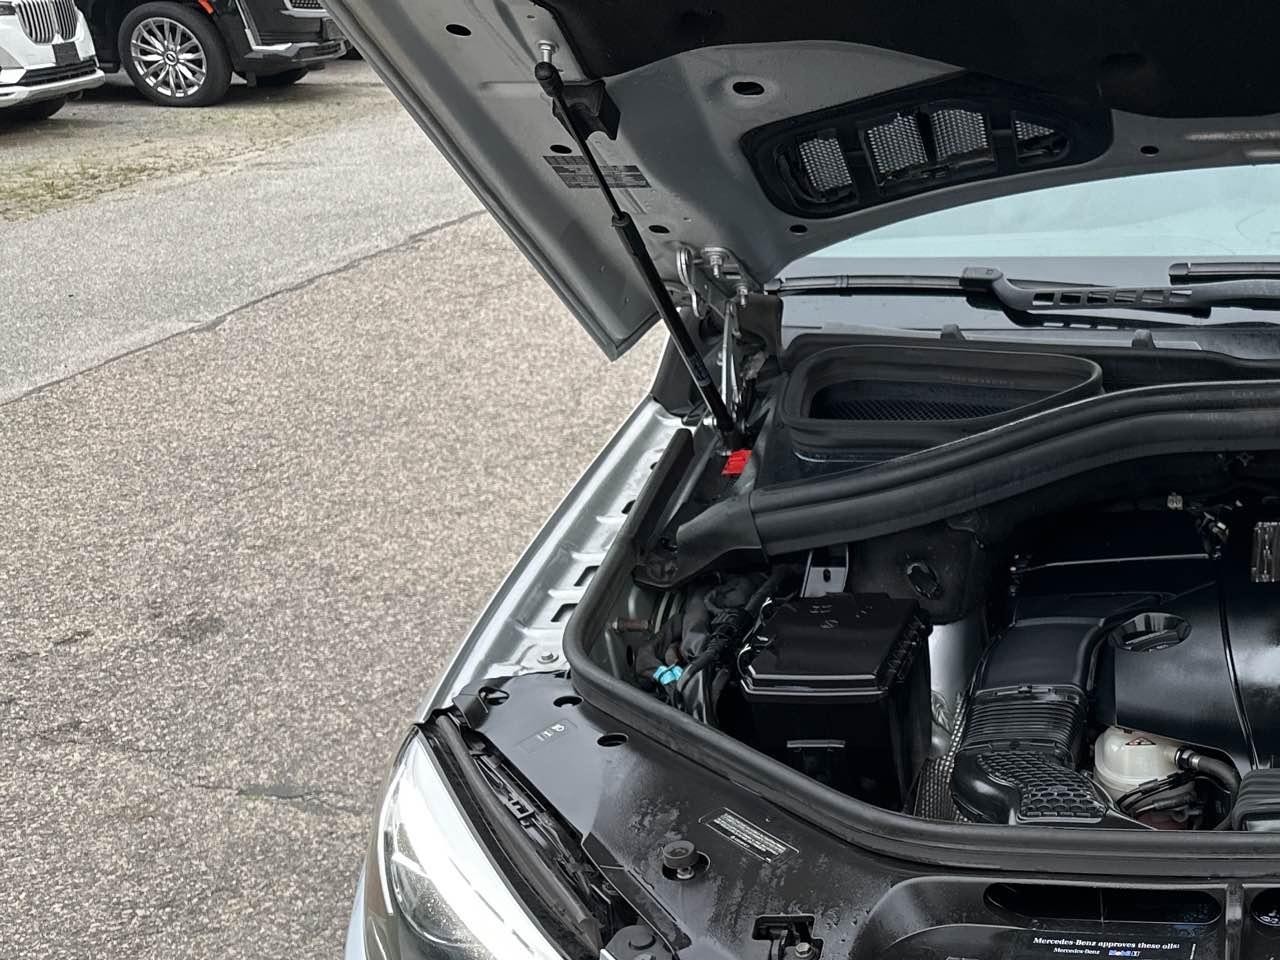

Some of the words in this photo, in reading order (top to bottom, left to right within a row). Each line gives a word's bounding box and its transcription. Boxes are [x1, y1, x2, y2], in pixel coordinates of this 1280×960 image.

[1032, 937, 1097, 946] Mercedes-Benz
[1098, 941, 1136, 949] approves
[1138, 941, 1161, 949] these
[1053, 946, 1101, 955] Mercedes-Benz
